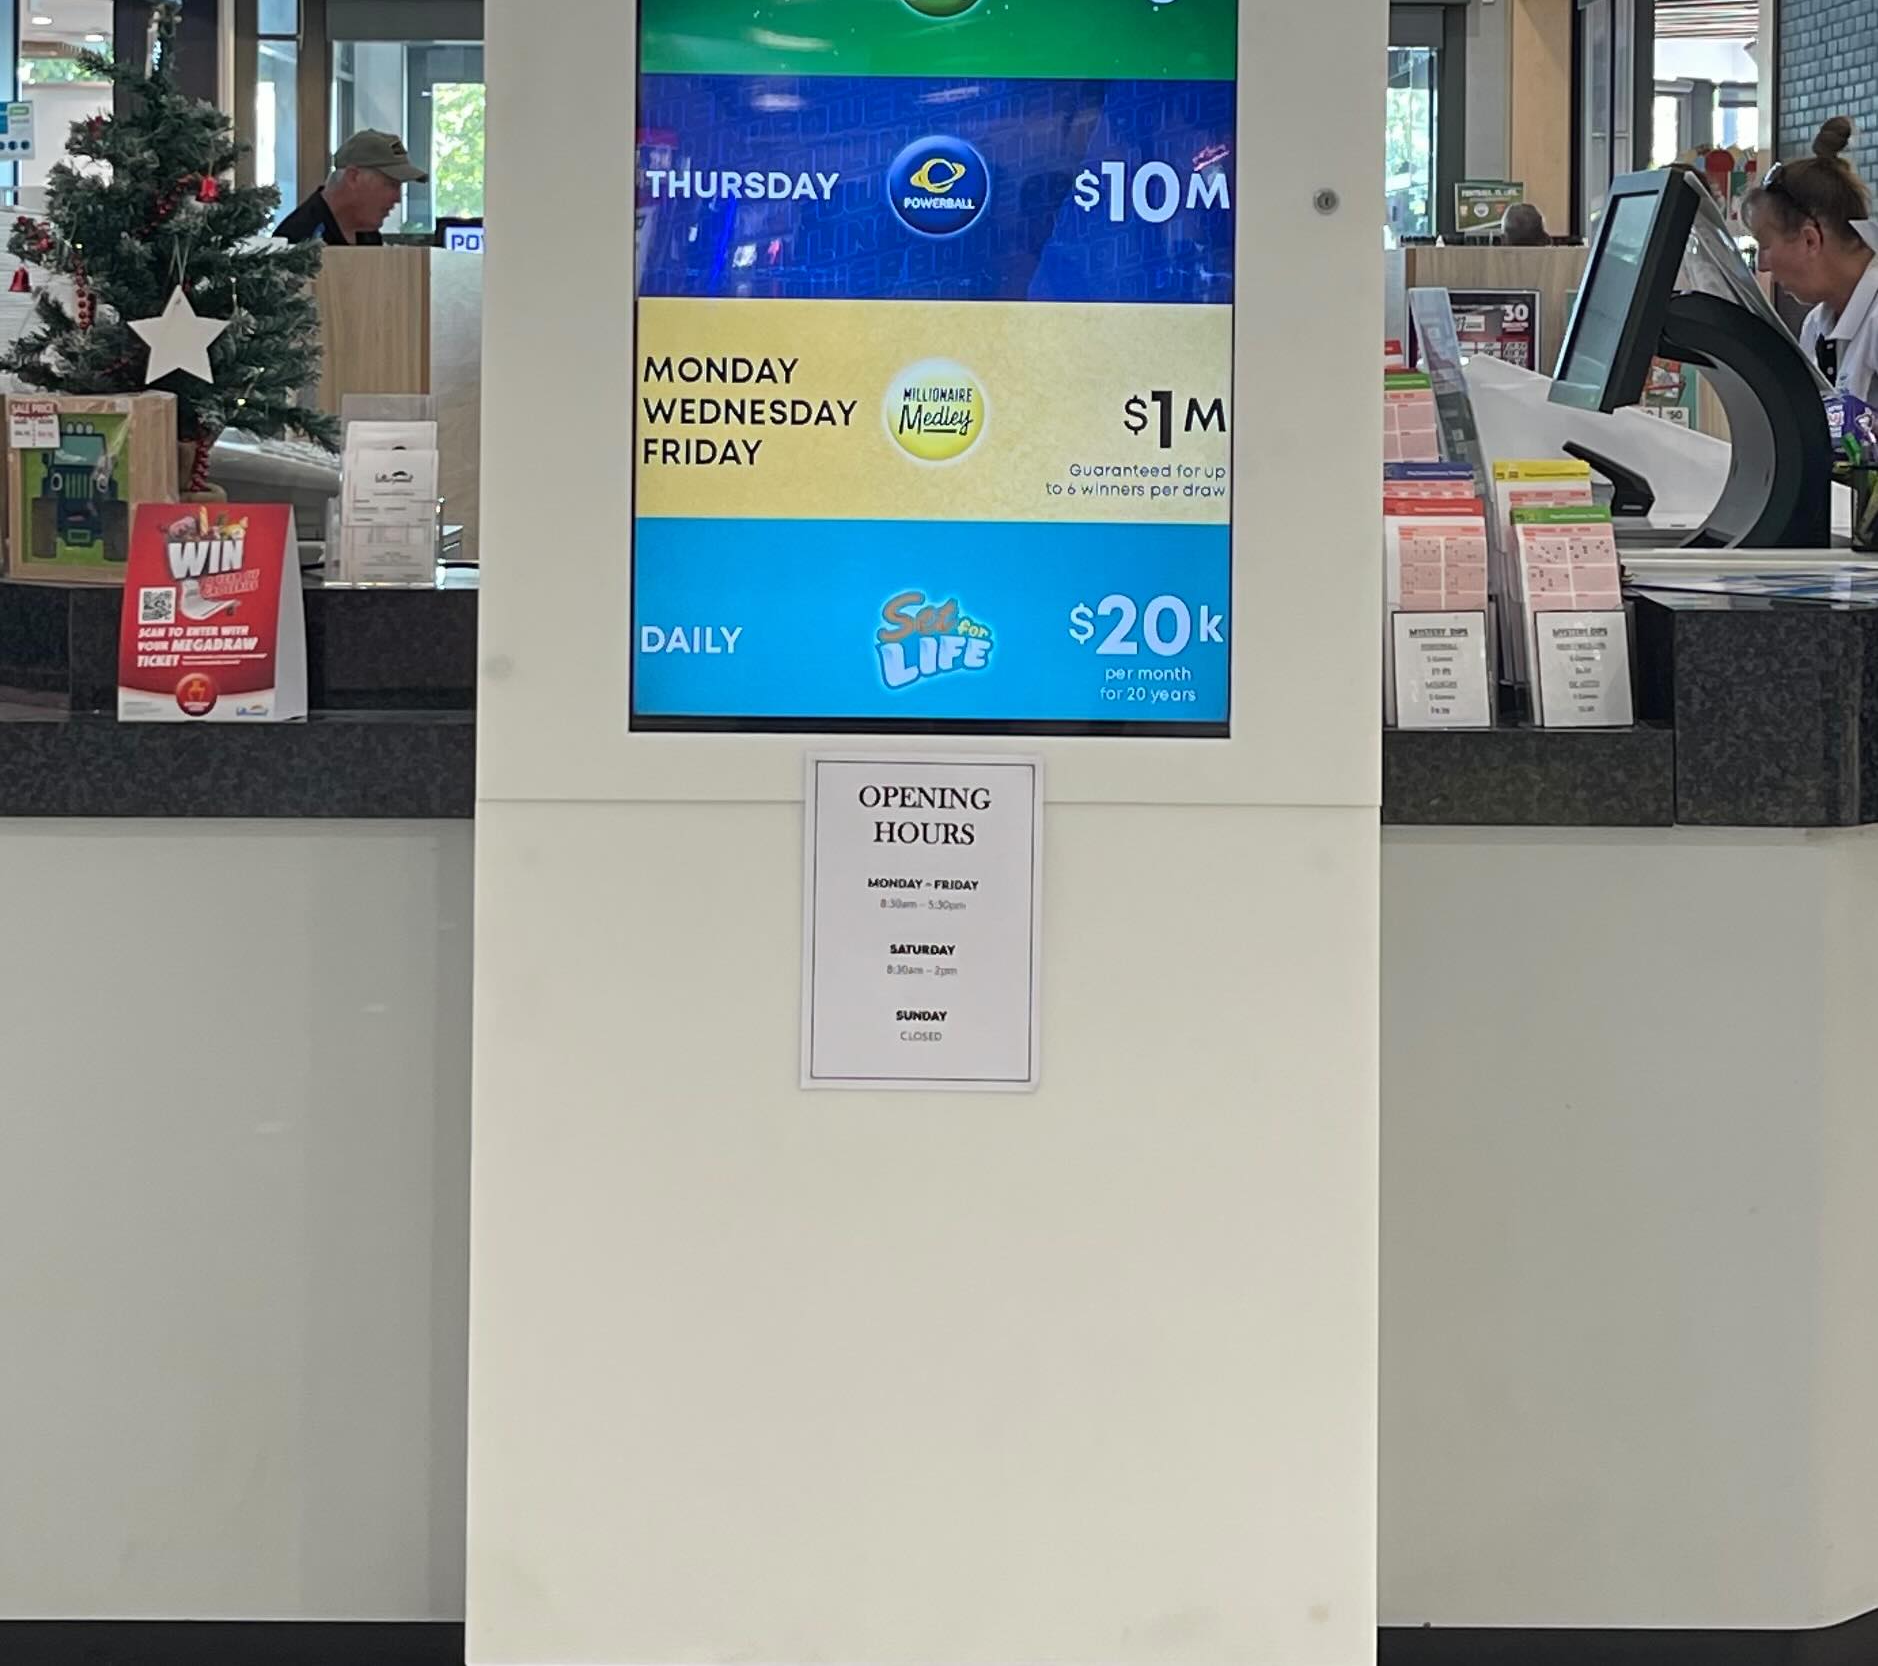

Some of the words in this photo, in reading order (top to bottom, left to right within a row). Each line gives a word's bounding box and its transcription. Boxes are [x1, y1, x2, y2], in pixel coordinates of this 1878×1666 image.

[646, 171, 839, 200] THURSDAY
[904, 197, 976, 210] POWERBALL
[1503, 304, 1529, 322] 30
[643, 356, 799, 385] MONDAY
[903, 387, 973, 403] MILLIONAIRE
[643, 397, 858, 426] WEDNESDAY
[898, 403, 974, 436] Medley
[642, 438, 762, 467] FRIDAY
[1069, 463, 1171, 478] Guaranteed
[1177, 464, 1200, 478] for
[1204, 466, 1226, 481] up
[1046, 483, 1062, 496] to
[1067, 483, 1076, 496] 6
[1081, 483, 1145, 497] winners
[1150, 485, 1178, 499] per
[1183, 483, 1226, 498] draw
[168, 539, 244, 579] WIN
[877, 591, 959, 643] Set
[138, 627, 166, 638] SCAN
[168, 627, 184, 637] TO
[186, 626, 219, 637] ENTER
[220, 625, 249, 636] WITH
[640, 625, 743, 655] DAILY
[137, 640, 169, 651] YOUR
[171, 637, 258, 652] MEGADRAW
[137, 654, 180, 668] TICKET
[876, 634, 993, 689] LIFE
[1105, 668, 1134, 683] per
[1138, 666, 1192, 681] month
[1100, 687, 1123, 701] for
[1127, 687, 1146, 701] 20
[1150, 689, 1197, 704] years
[858, 785, 992, 811] OPENING
[873, 821, 976, 846] HOURS
[868, 877, 923, 890] MONDAY
[934, 879, 979, 891] FRIDAY
[880, 899, 917, 910] 8:30am
[928, 900, 967, 912] 5:30pm
[890, 944, 956, 956] SATURDAY
[886, 965, 924, 976] 8:30am
[934, 965, 958, 978] 2pm
[896, 1010, 948, 1022] SUNDAY
[900, 1031, 942, 1042] CLOSED
